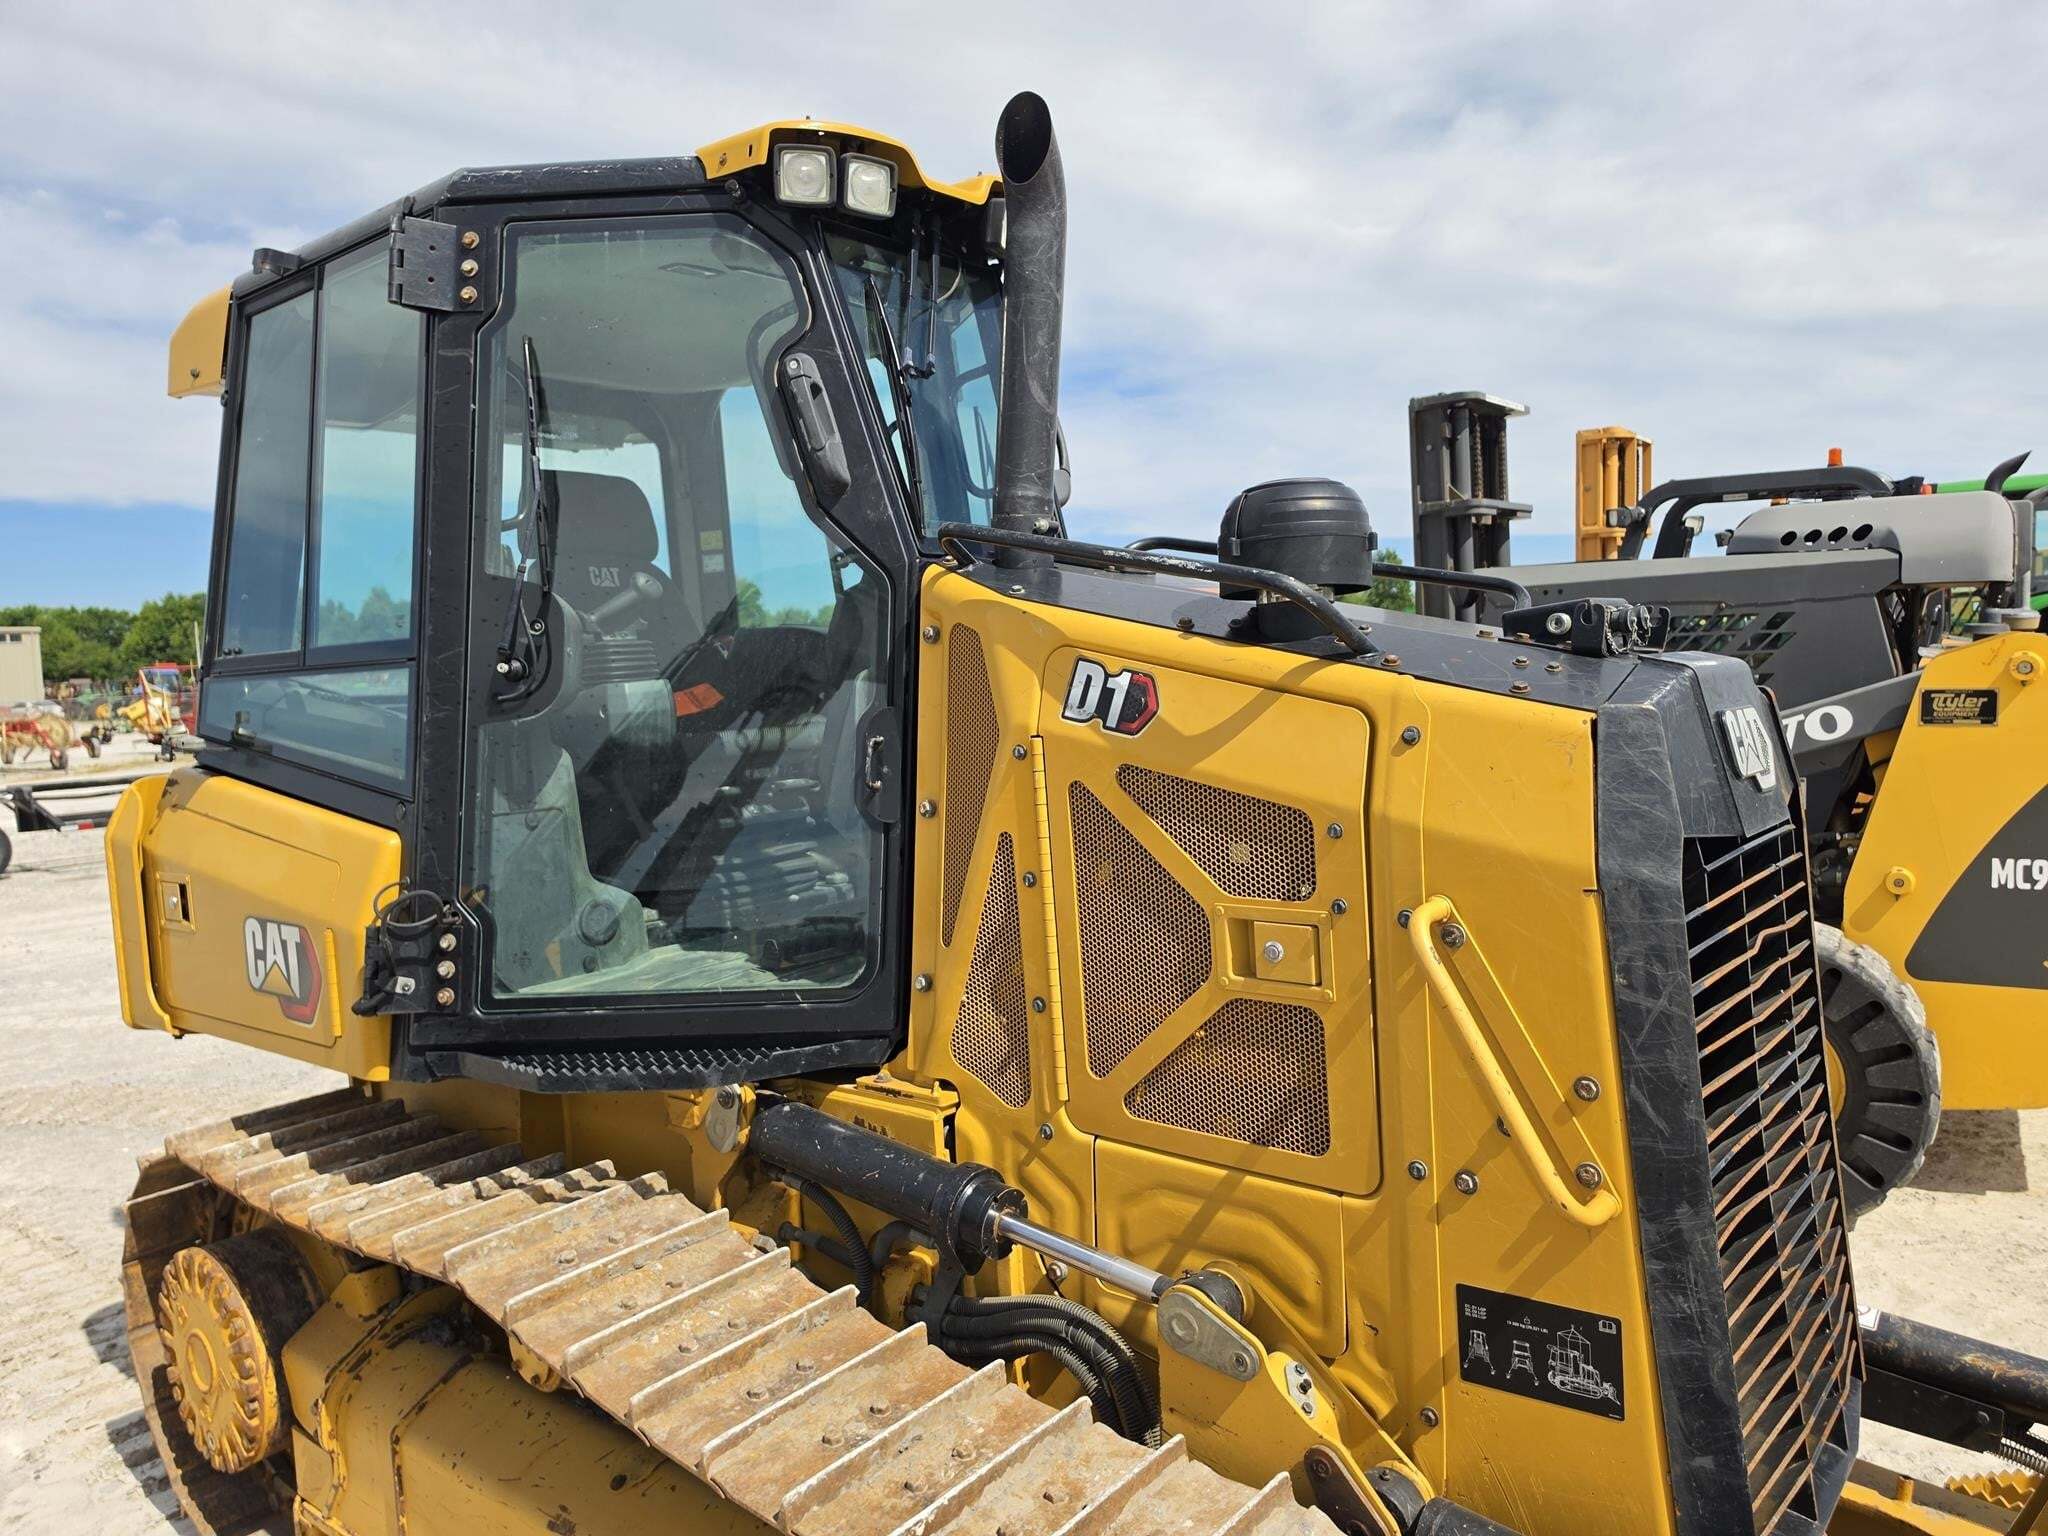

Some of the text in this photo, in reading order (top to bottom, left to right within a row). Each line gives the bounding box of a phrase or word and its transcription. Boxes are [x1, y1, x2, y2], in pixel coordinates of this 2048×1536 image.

[588, 566, 620, 587] CAT
[1063, 660, 1132, 728] D1
[1931, 693, 1988, 711] Tyler
[1723, 706, 1768, 777] CAT
[244, 917, 301, 1000] CAT
